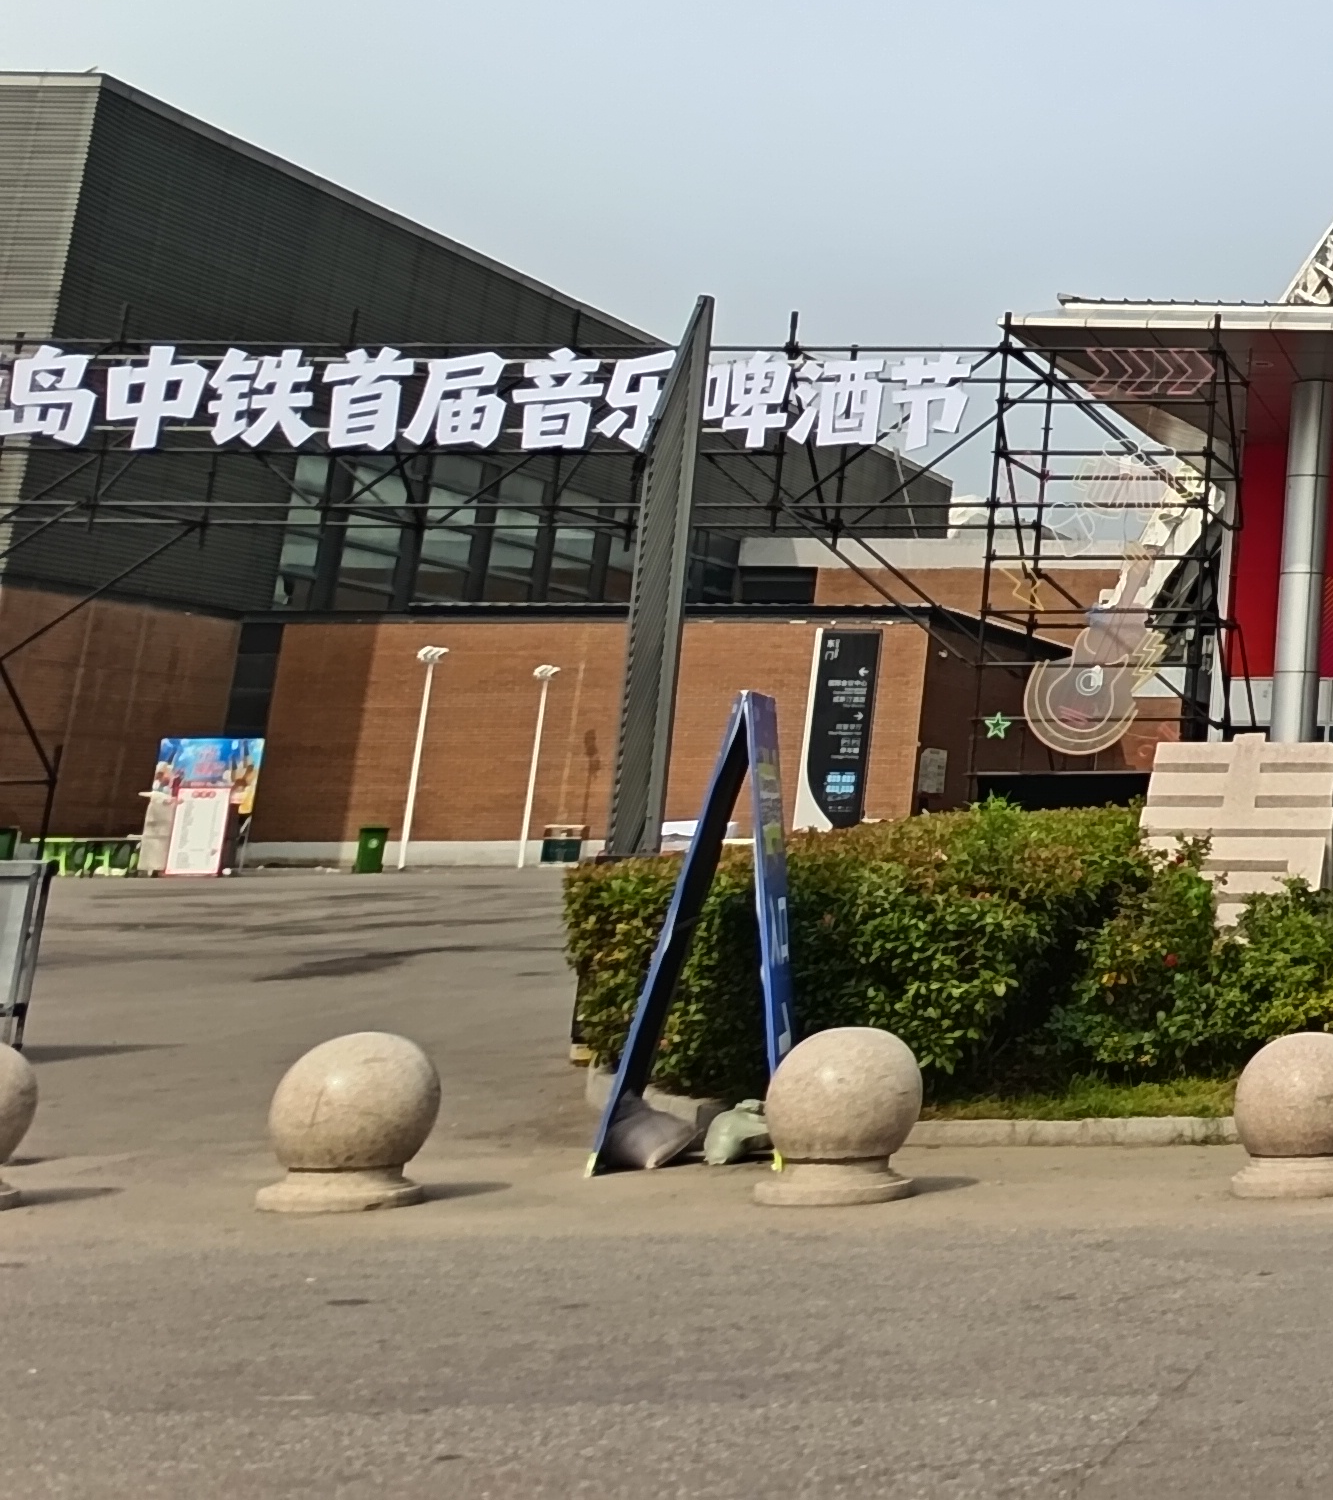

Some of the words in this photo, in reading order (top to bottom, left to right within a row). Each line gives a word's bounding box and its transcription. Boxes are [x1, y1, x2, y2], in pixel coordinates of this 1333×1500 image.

[2, 344, 976, 452] 岛中铁首届音乐啤酒节
